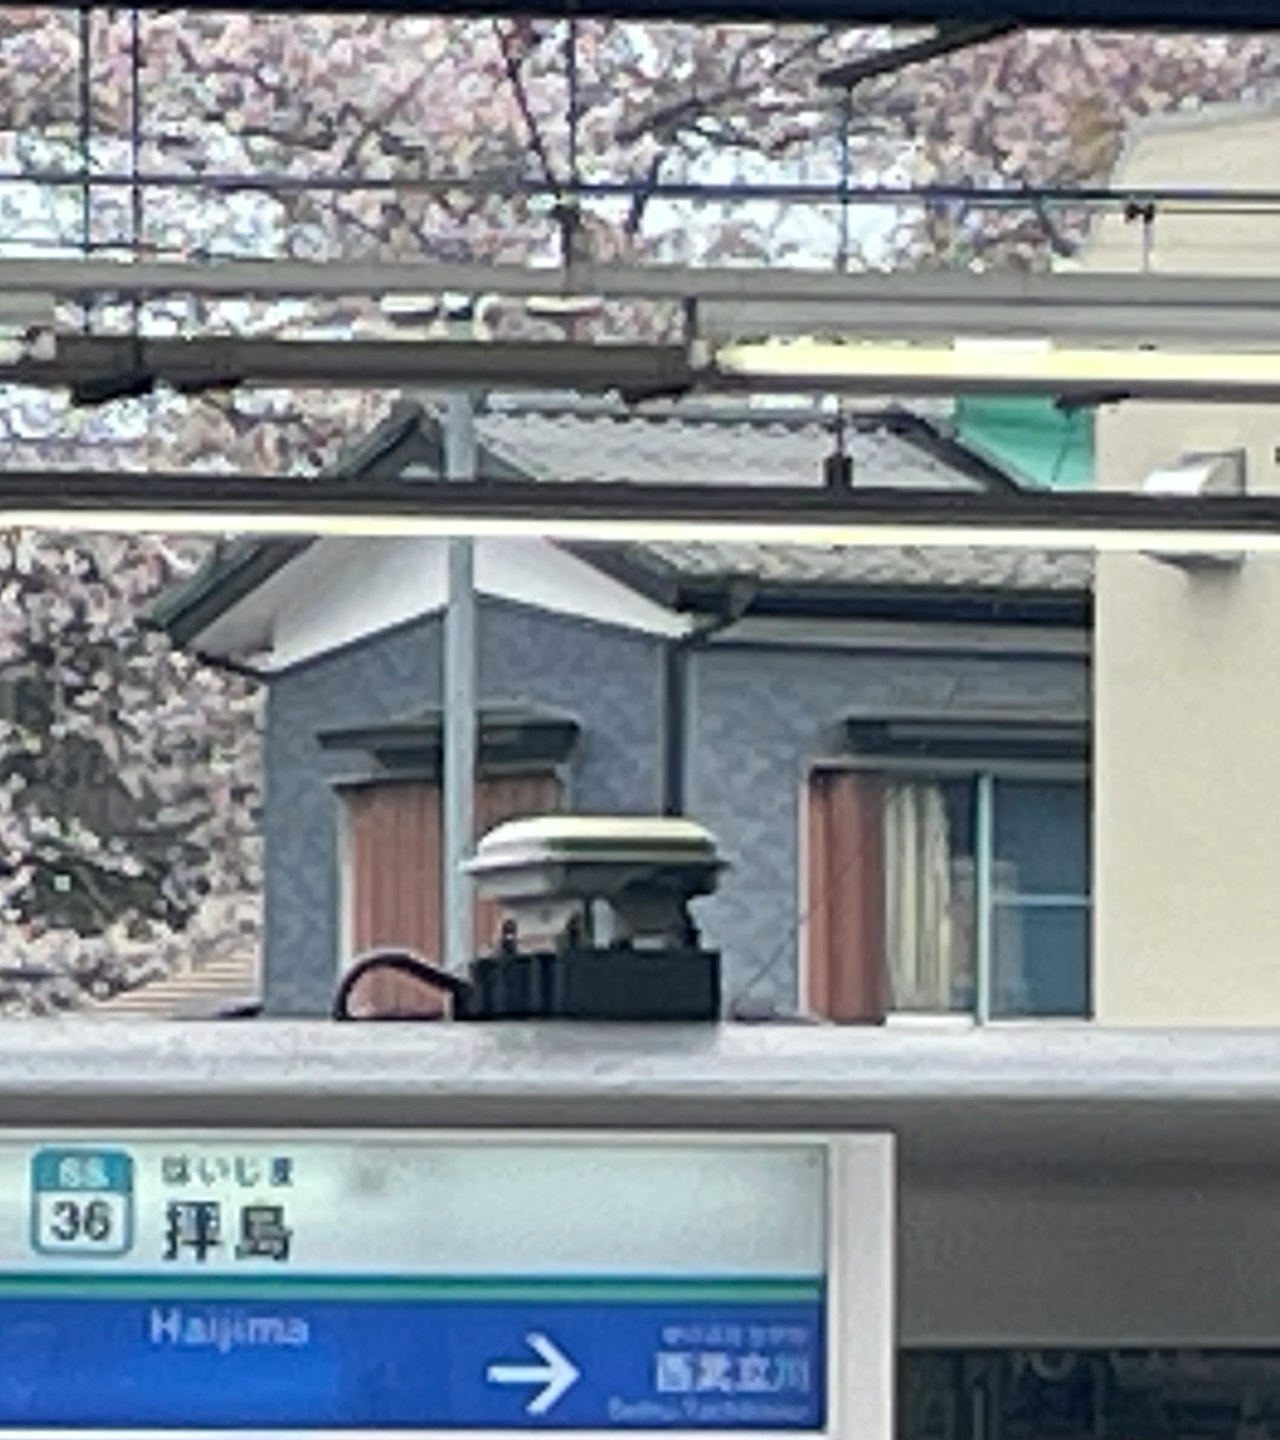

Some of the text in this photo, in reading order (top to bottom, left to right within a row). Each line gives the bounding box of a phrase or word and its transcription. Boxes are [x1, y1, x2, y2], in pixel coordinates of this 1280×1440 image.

[50, 1201, 111, 1241] 36
[162, 1201, 293, 1261] 拝島
[150, 1307, 309, 1352] Haijima
